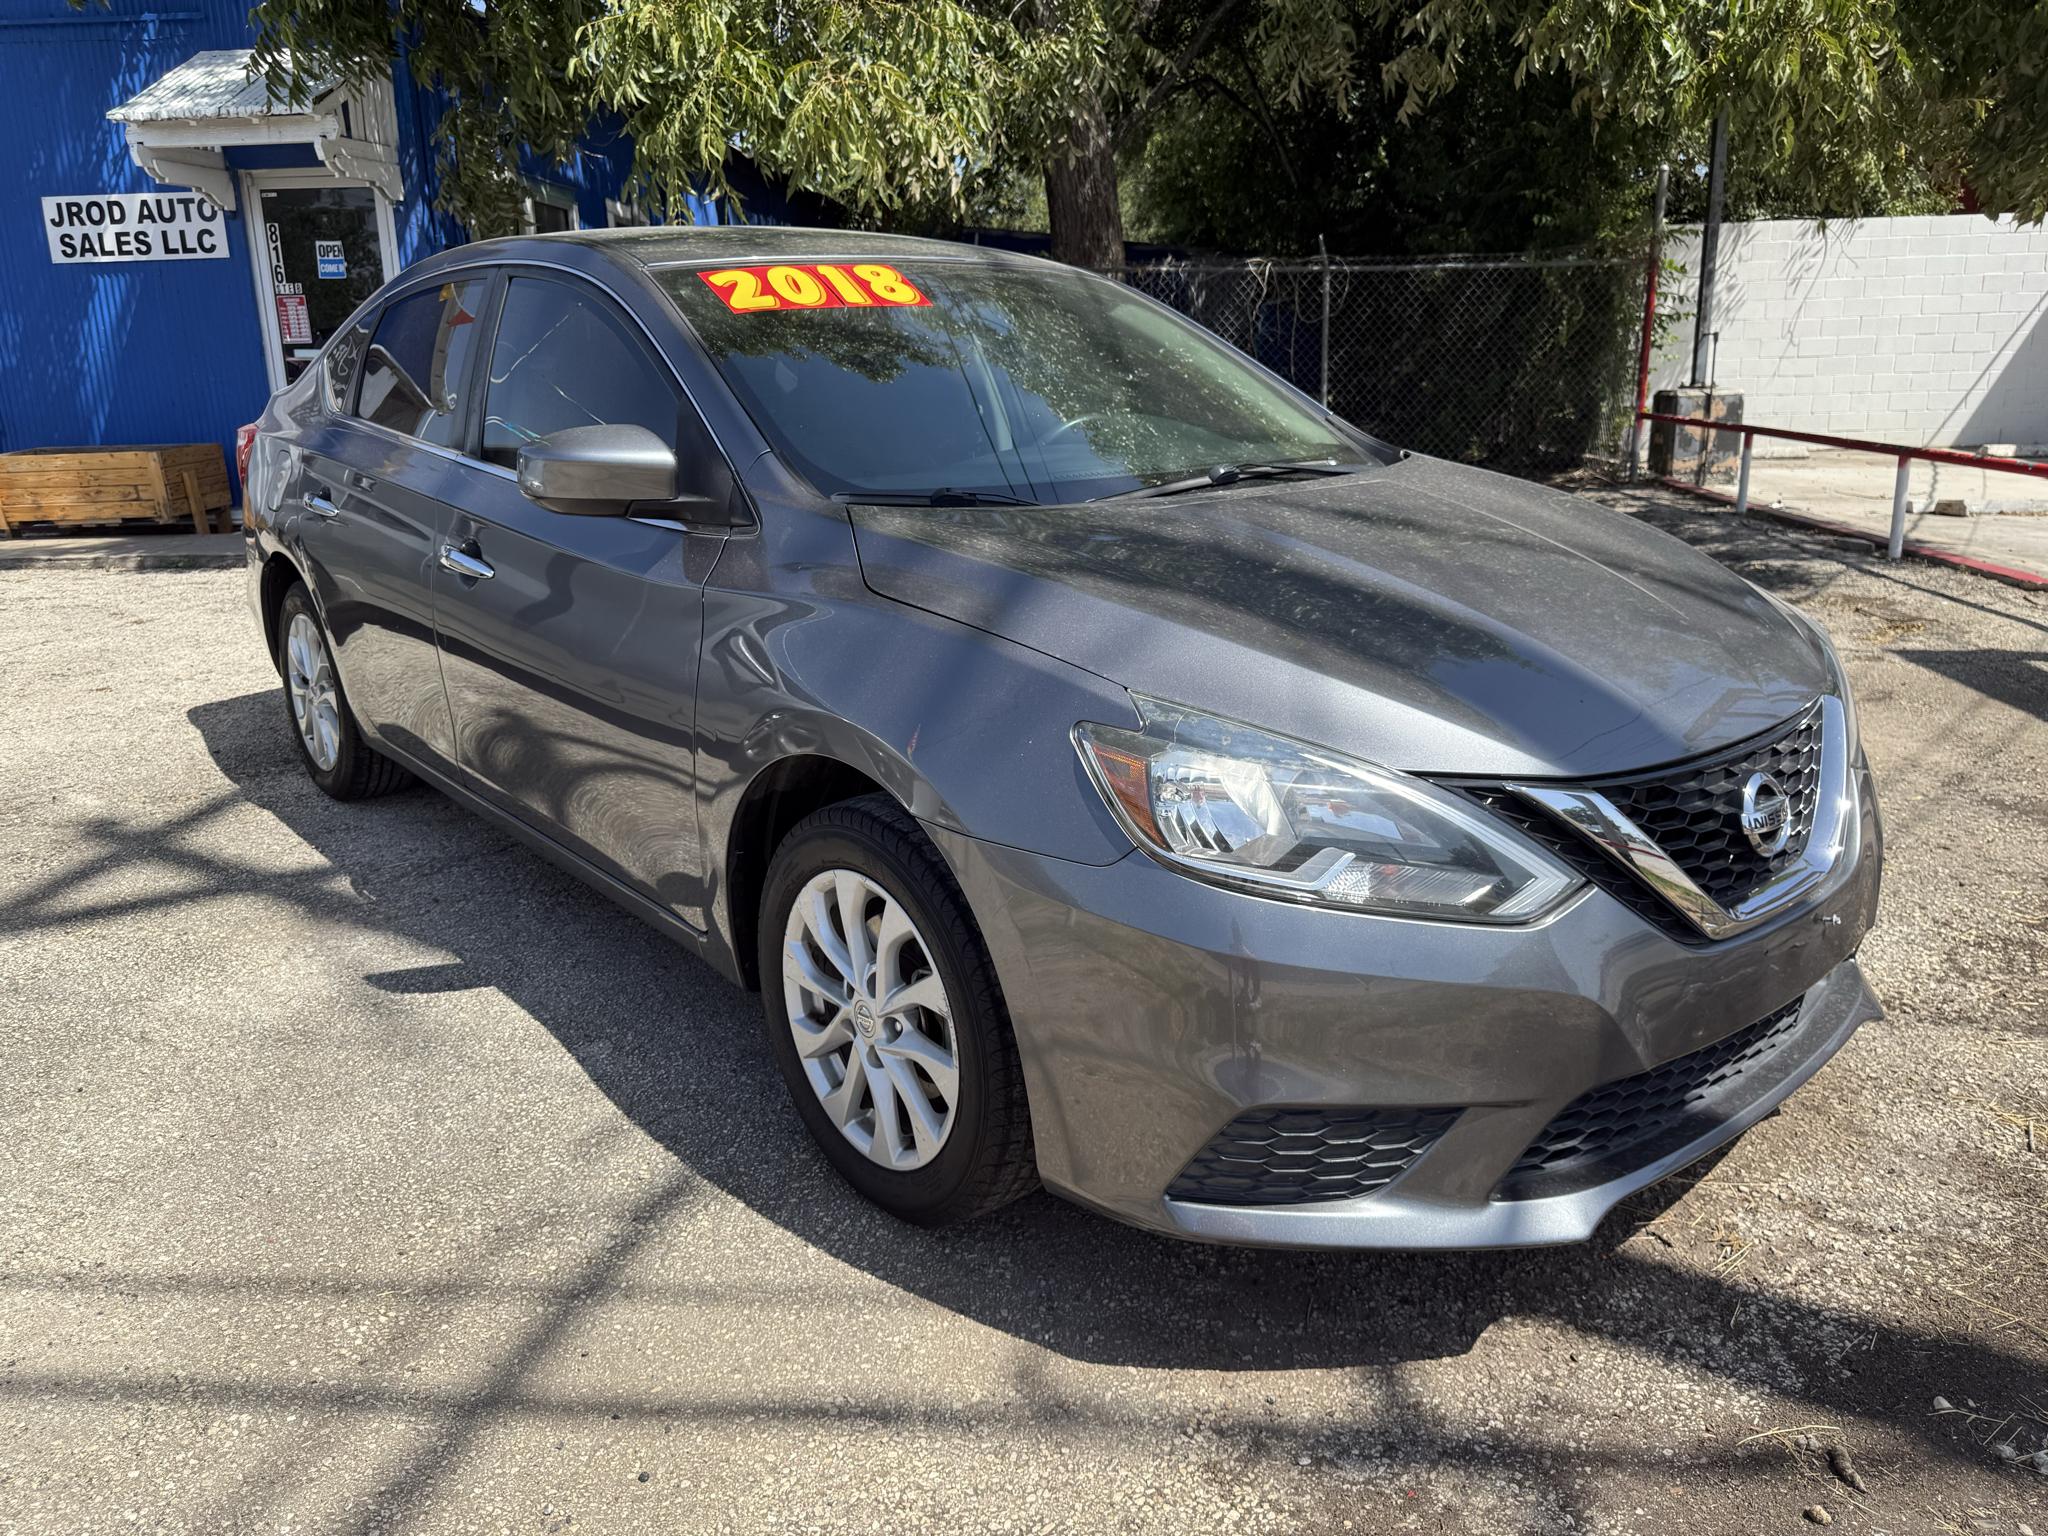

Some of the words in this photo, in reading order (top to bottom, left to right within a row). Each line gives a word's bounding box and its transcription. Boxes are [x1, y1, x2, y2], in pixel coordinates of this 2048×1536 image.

[50, 200, 126, 228] JROD
[137, 197, 218, 225] AUTO
[59, 230, 152, 259] SALES
[161, 228, 217, 255] LLC
[268, 223, 284, 284] 816
[318, 244, 344, 258] OPEN
[320, 263, 339, 273] COME
[708, 264, 921, 310] 2018
